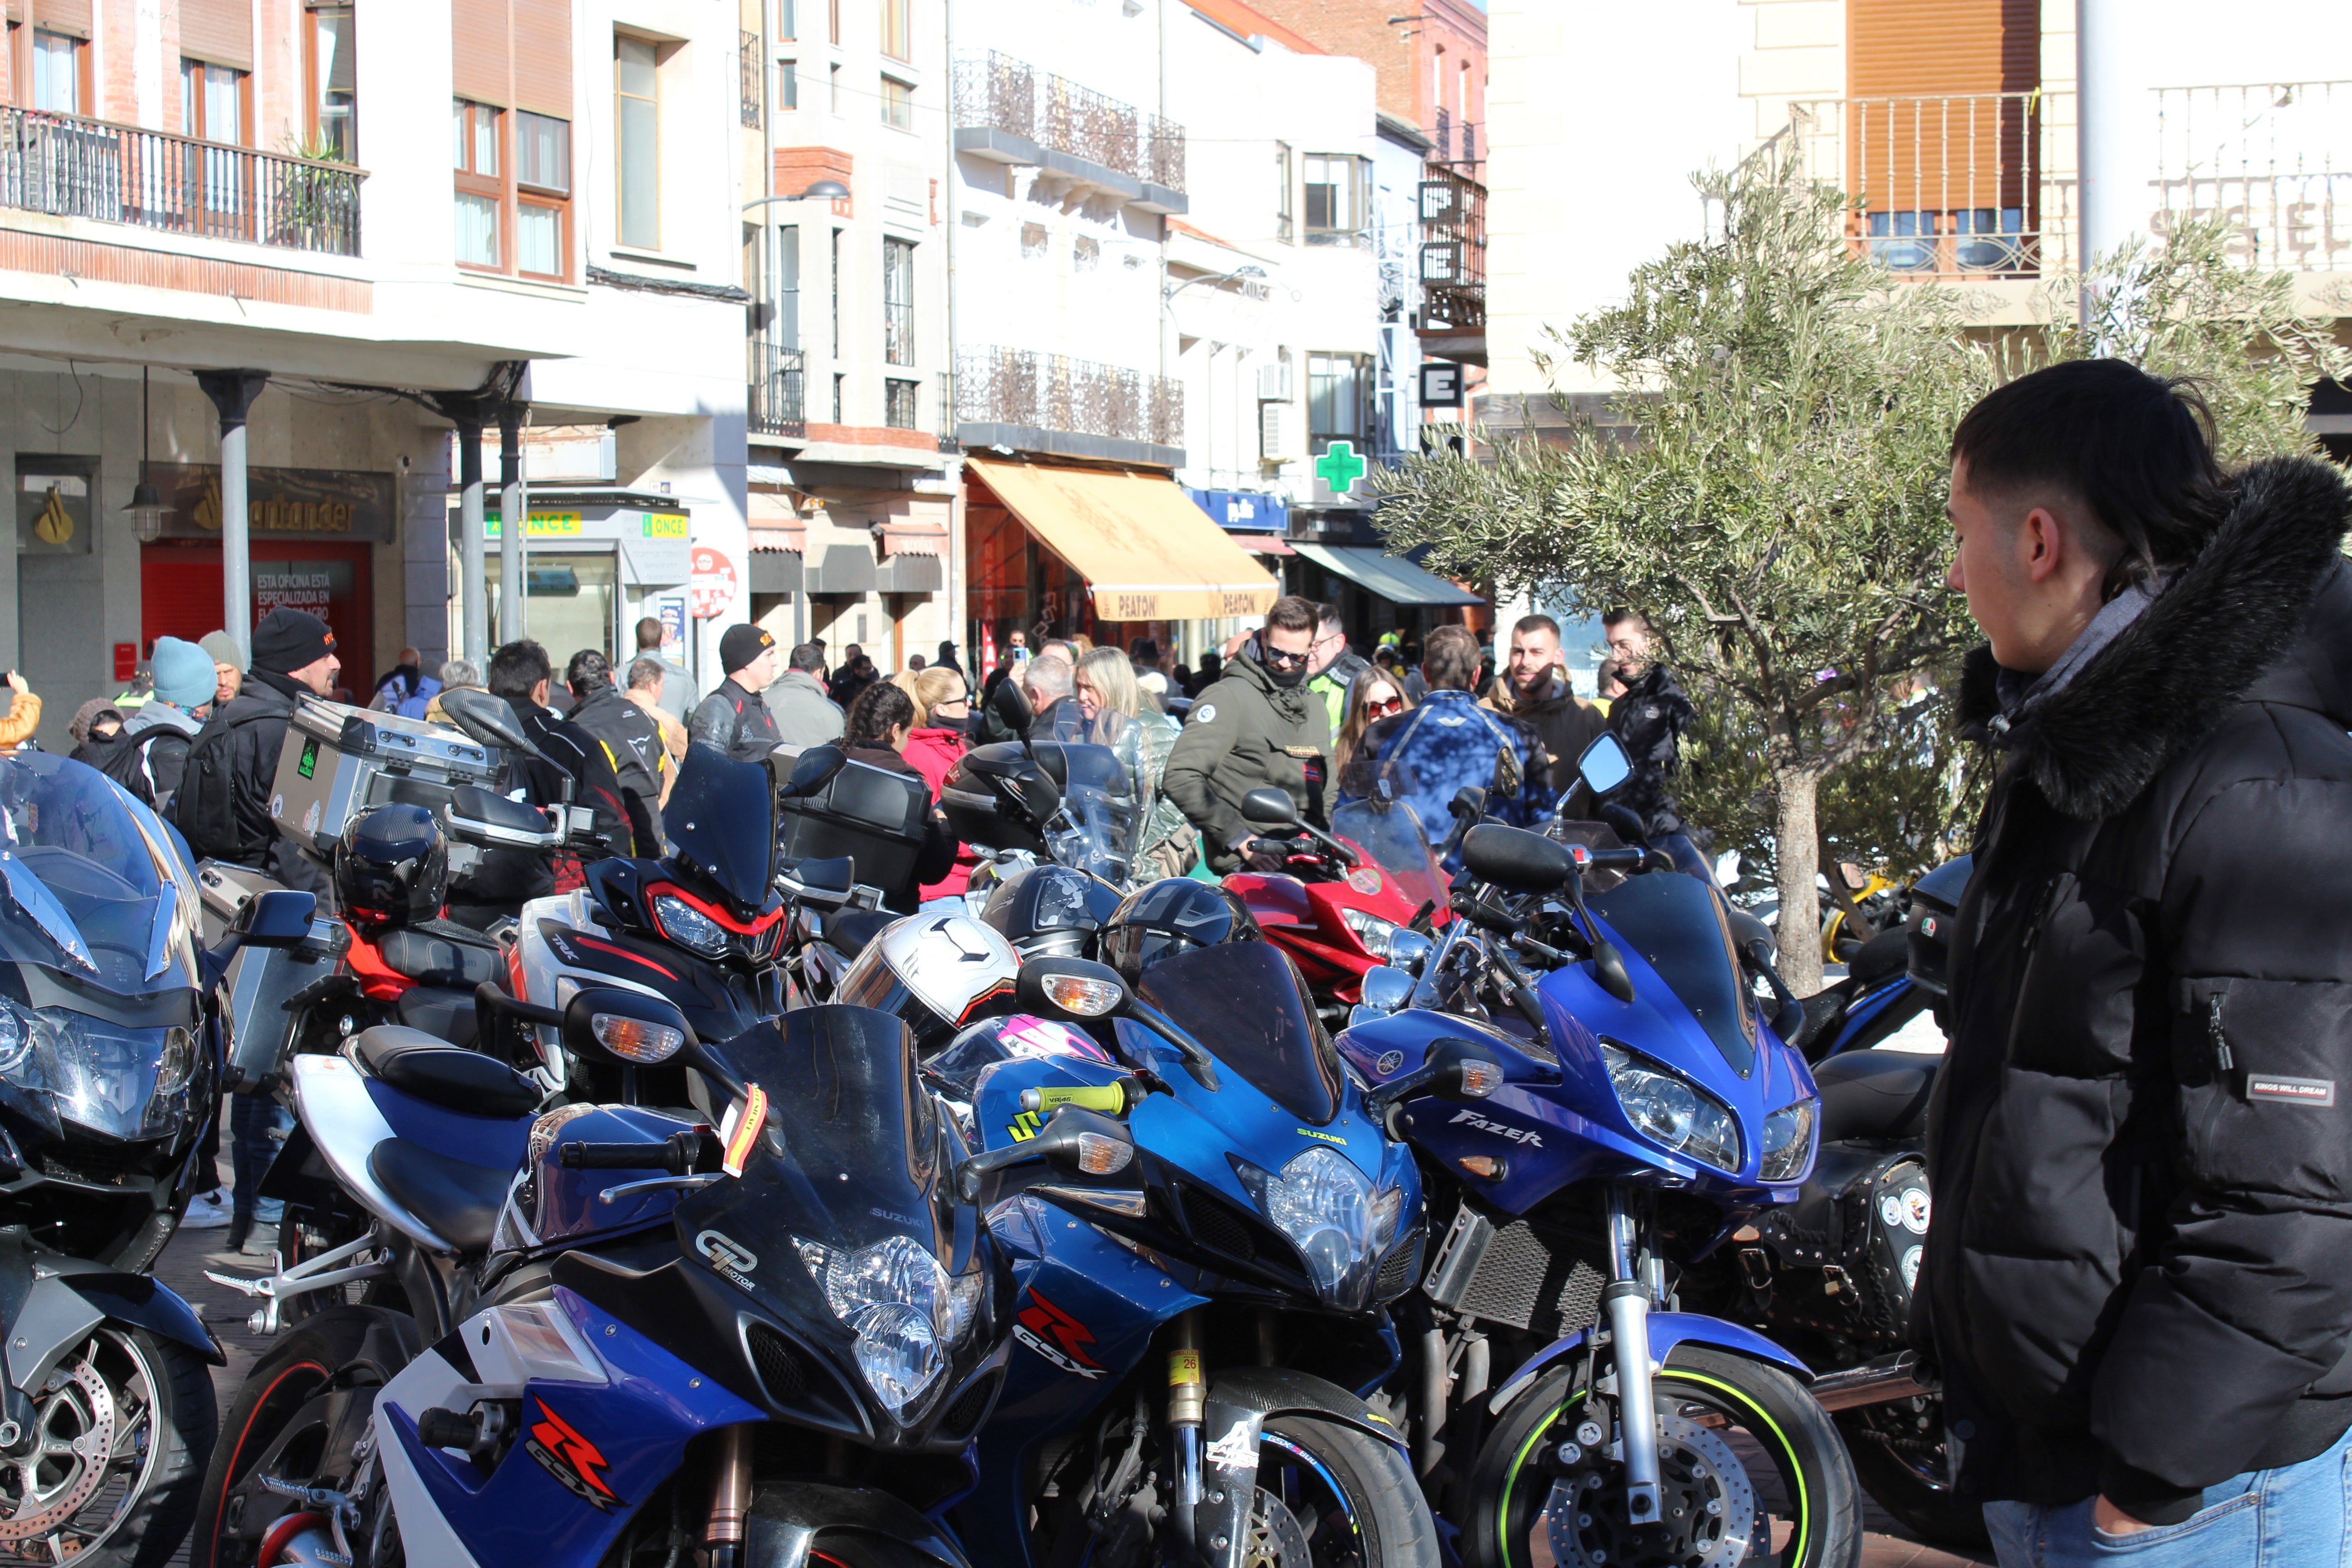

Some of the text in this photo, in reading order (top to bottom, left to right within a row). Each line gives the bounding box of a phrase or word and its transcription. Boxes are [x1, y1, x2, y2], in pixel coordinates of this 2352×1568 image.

[249, 494, 357, 531] antander
[656, 519, 682, 534] ONCE
[258, 571, 330, 588] ESTA OFICINA ESTÁ
[258, 591, 329, 605] ESPECIALIZADA EN
[1105, 853, 1127, 863] HONDA
[552, 933, 579, 960] TRK
[2254, 1082, 2327, 1096] KINGS WILL DREAM
[1297, 1127, 1348, 1146] SUZUKI
[1448, 1109, 1544, 1148] FAZER
[872, 1207, 925, 1228] SUZUKI
[721, 1266, 756, 1290] MOTOR
[1012, 1324, 1108, 1380] GSX
[1184, 1358, 1197, 1369] 26
[525, 1439, 617, 1510] GSX
